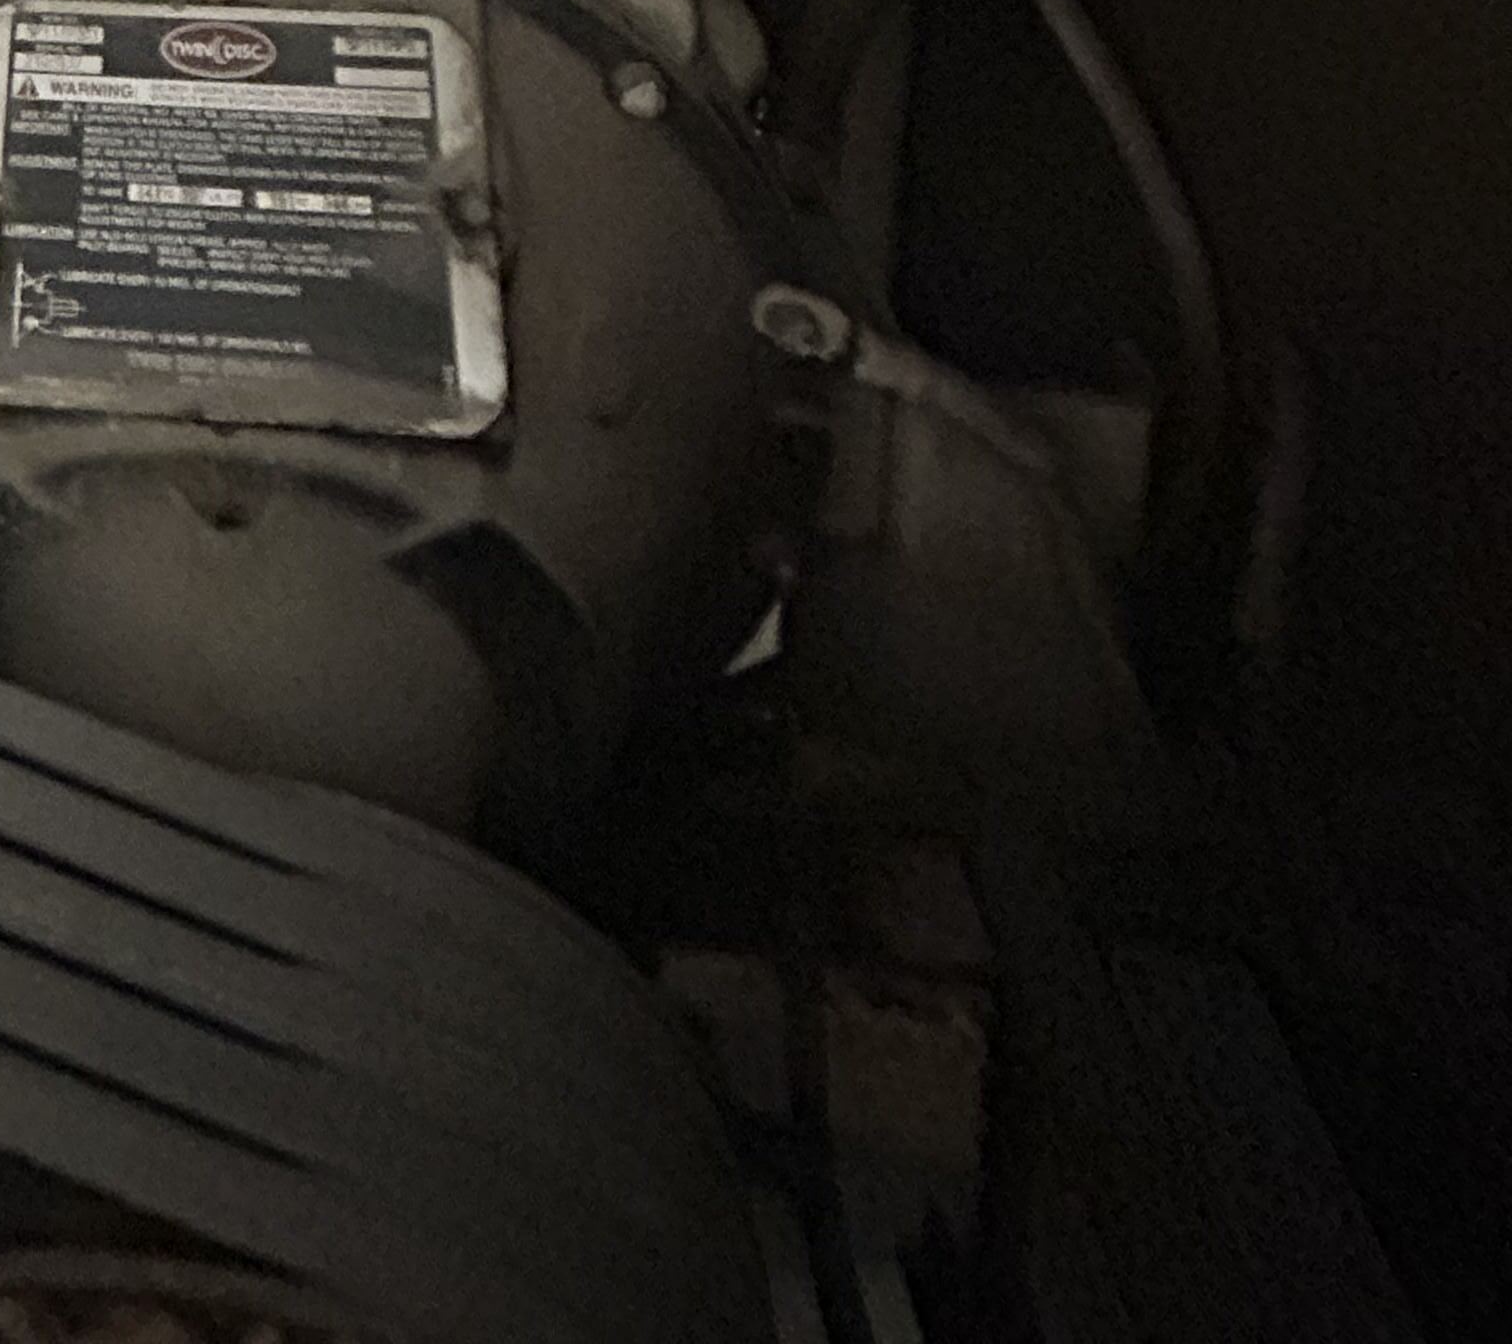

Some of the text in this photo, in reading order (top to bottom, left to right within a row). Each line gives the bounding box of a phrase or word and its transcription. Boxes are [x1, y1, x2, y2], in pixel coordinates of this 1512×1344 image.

[171, 40, 267, 61] TWIN DISC
[48, 79, 136, 99] WARNING
